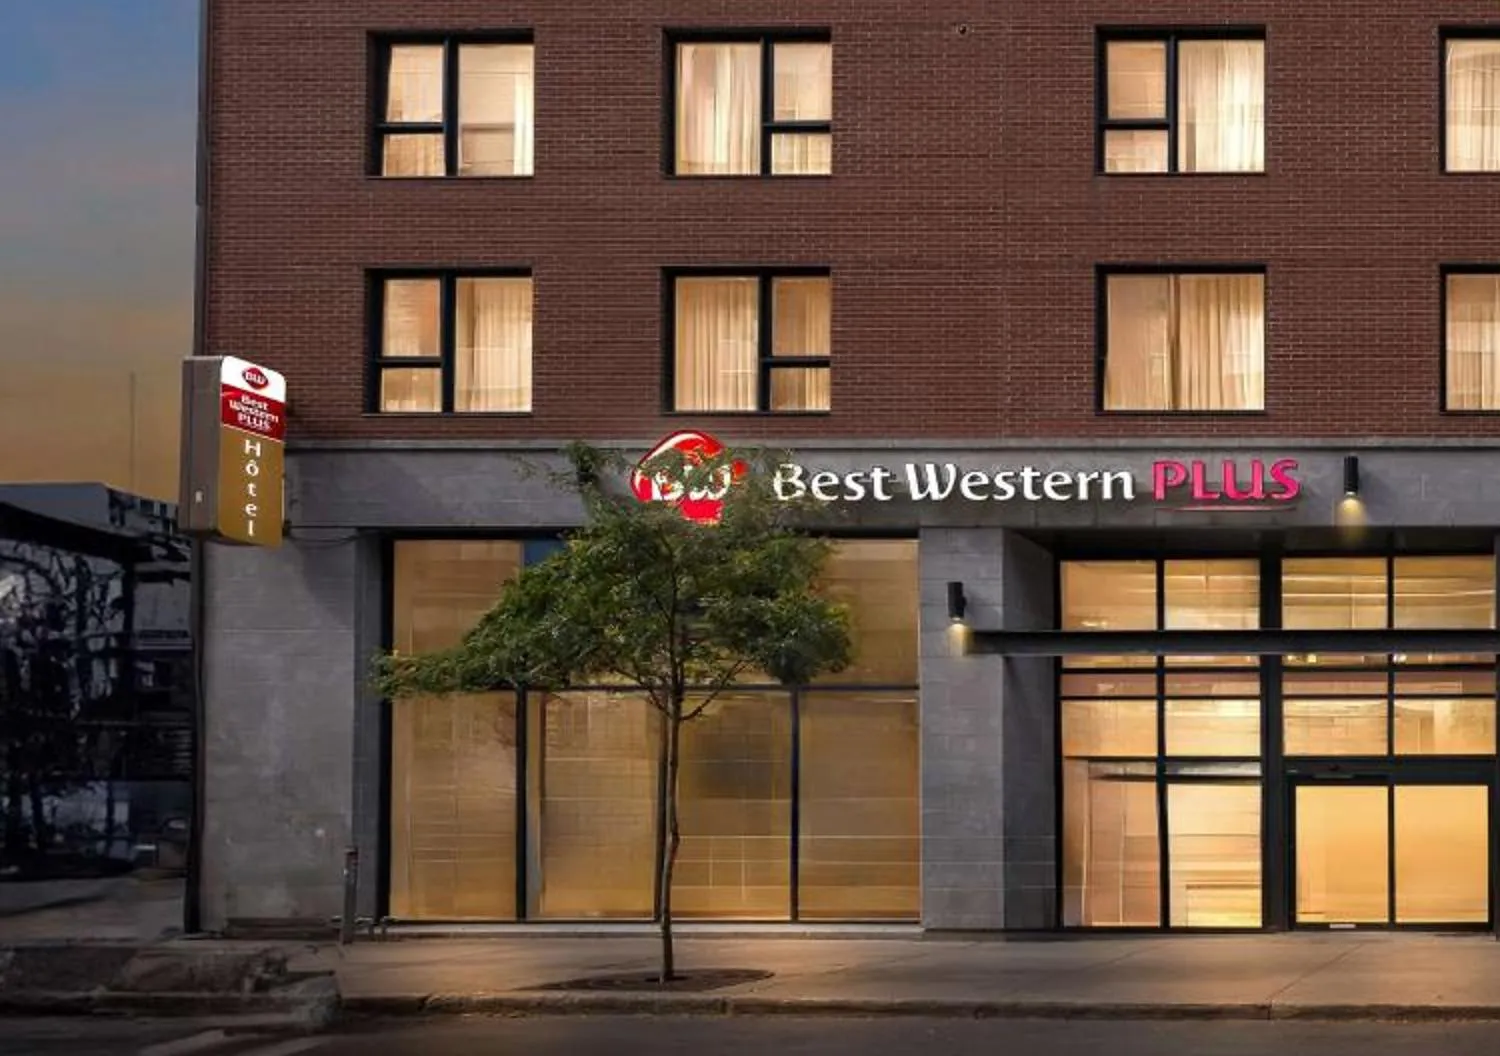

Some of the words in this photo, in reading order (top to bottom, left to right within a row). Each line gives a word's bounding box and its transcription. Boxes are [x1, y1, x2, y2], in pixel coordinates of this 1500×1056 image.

[229, 400, 279, 423] Western
[241, 394, 268, 410] Best
[245, 439, 261, 536] Hôtel
[773, 463, 894, 501] Best
[904, 462, 1136, 501] Western
[1151, 459, 1300, 501] PLUS
